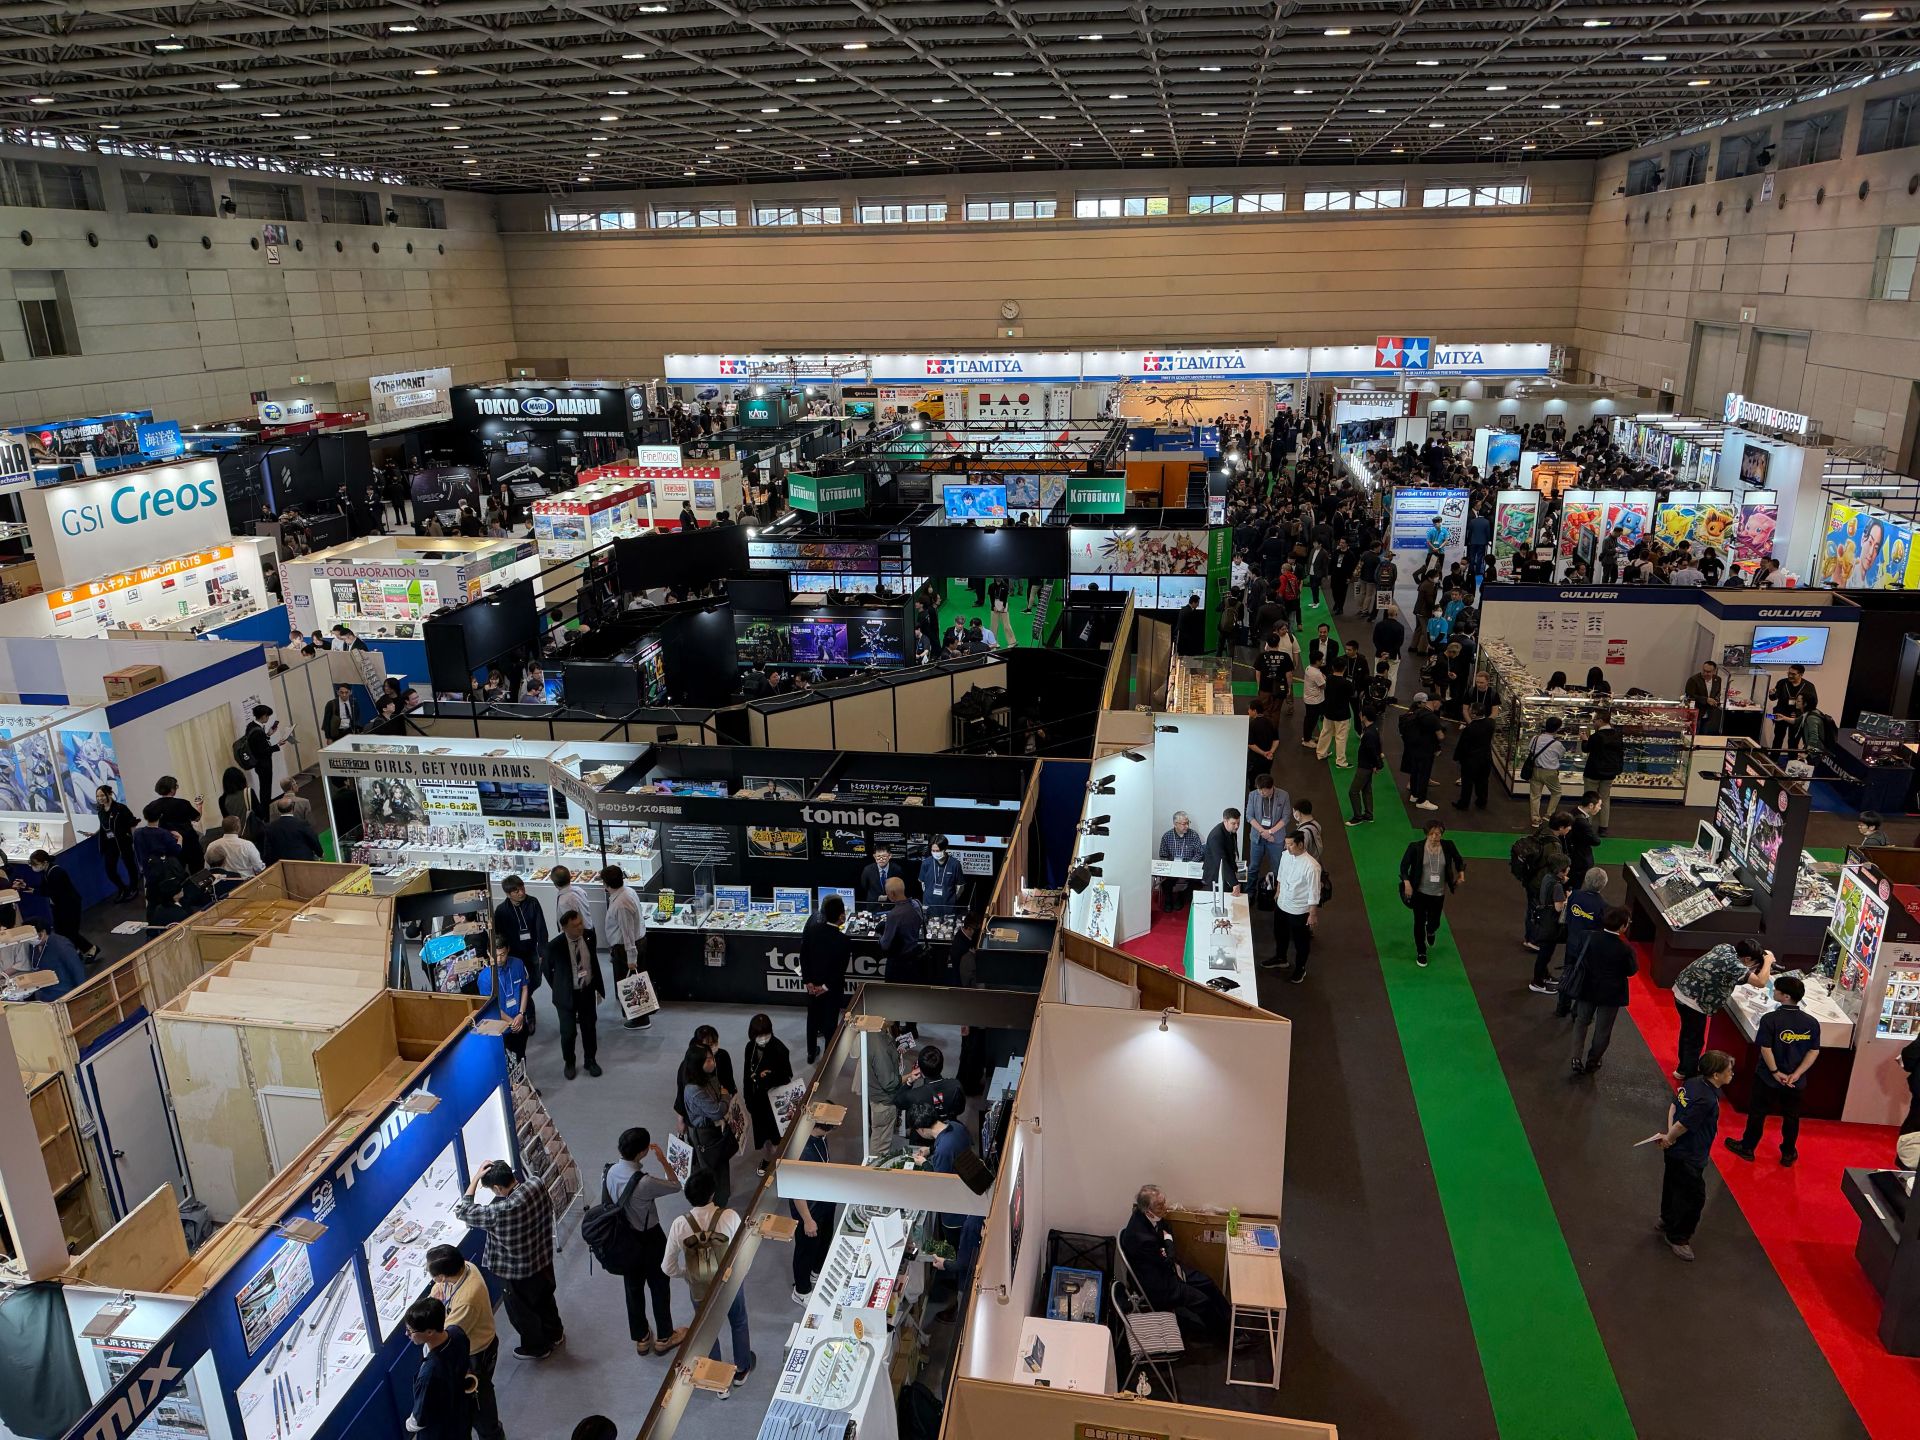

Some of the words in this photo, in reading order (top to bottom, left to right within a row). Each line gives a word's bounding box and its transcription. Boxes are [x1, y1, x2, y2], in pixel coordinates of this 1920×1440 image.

[1175, 356, 1246, 369] TAMIYA
[1434, 351, 1484, 364] MIYA
[957, 360, 1023, 373] TAMIYA
[396, 376, 425, 390] HORNET
[475, 399, 519, 415] TOKYO
[556, 399, 600, 415] MARUI
[748, 409, 768, 419] KATO
[979, 408, 1030, 416] PLATZ
[1739, 402, 1771, 425] BANDAI
[1772, 409, 1803, 433] HOBBY
[144, 429, 176, 447] 海洋堂
[0, 444, 28, 475] HA
[642, 451, 677, 462] FineMolds
[790, 484, 816, 500] KOTOBUKIYA
[820, 487, 861, 502] KOTOBUKIYA
[1070, 489, 1120, 503] KOTOBUKIYA
[62, 504, 104, 536] GSI
[111, 480, 217, 524] Creos
[89, 575, 132, 595] 輸入キット
[140, 561, 177, 580] IMPORT
[180, 555, 201, 568] KITS
[327, 566, 415, 578] COLLABORATION
[456, 566, 467, 592] NEW
[280, 563, 297, 631] COLLABORATIO
[1560, 591, 1619, 600] GULLIVER
[1758, 610, 1822, 618] GULLIVER
[374, 760, 418, 776] GIRLS,
[421, 762, 446, 775] GET
[449, 762, 487, 777] YOUR
[491, 763, 536, 778] ARMS.
[800, 805, 900, 828] tomica
